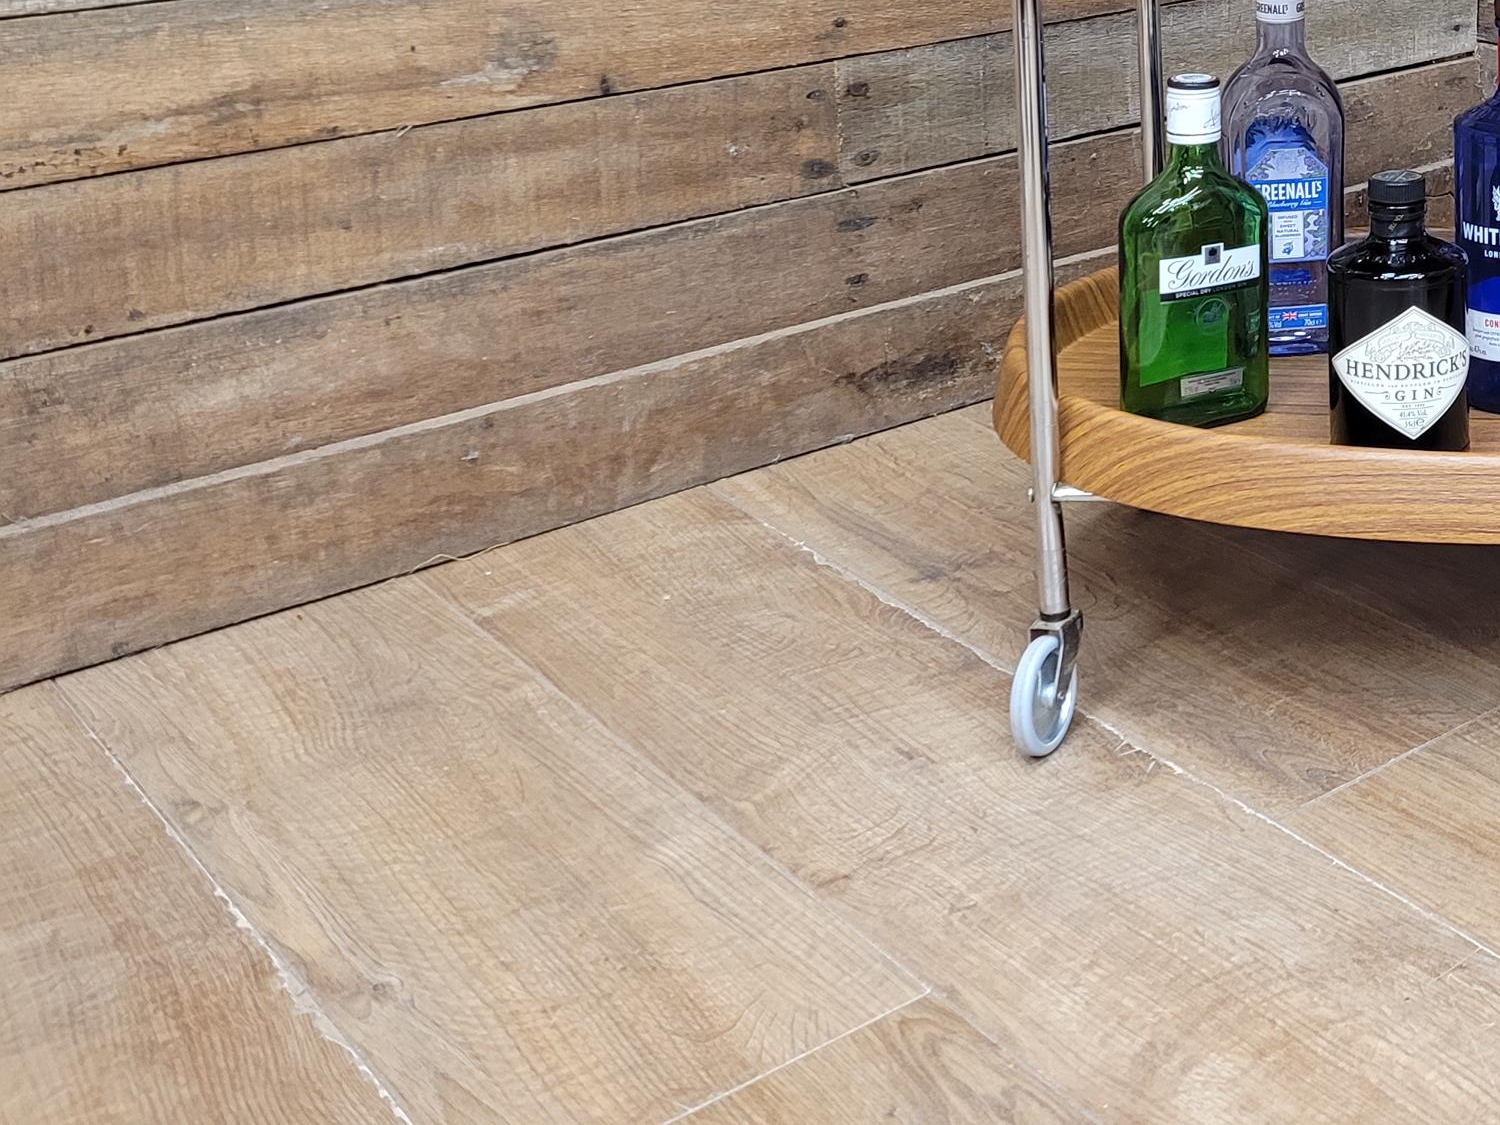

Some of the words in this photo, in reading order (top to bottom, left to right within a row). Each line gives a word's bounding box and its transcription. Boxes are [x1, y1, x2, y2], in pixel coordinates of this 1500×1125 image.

[1256, 2, 1289, 15] REENALL'S
[1256, 181, 1322, 201] REENALL'S
[1168, 255, 1254, 290] Gordon's
[1175, 290, 1199, 299] SPECIAL
[1345, 349, 1467, 381] HENDRICK'S
[1395, 387, 1434, 401] GIN
